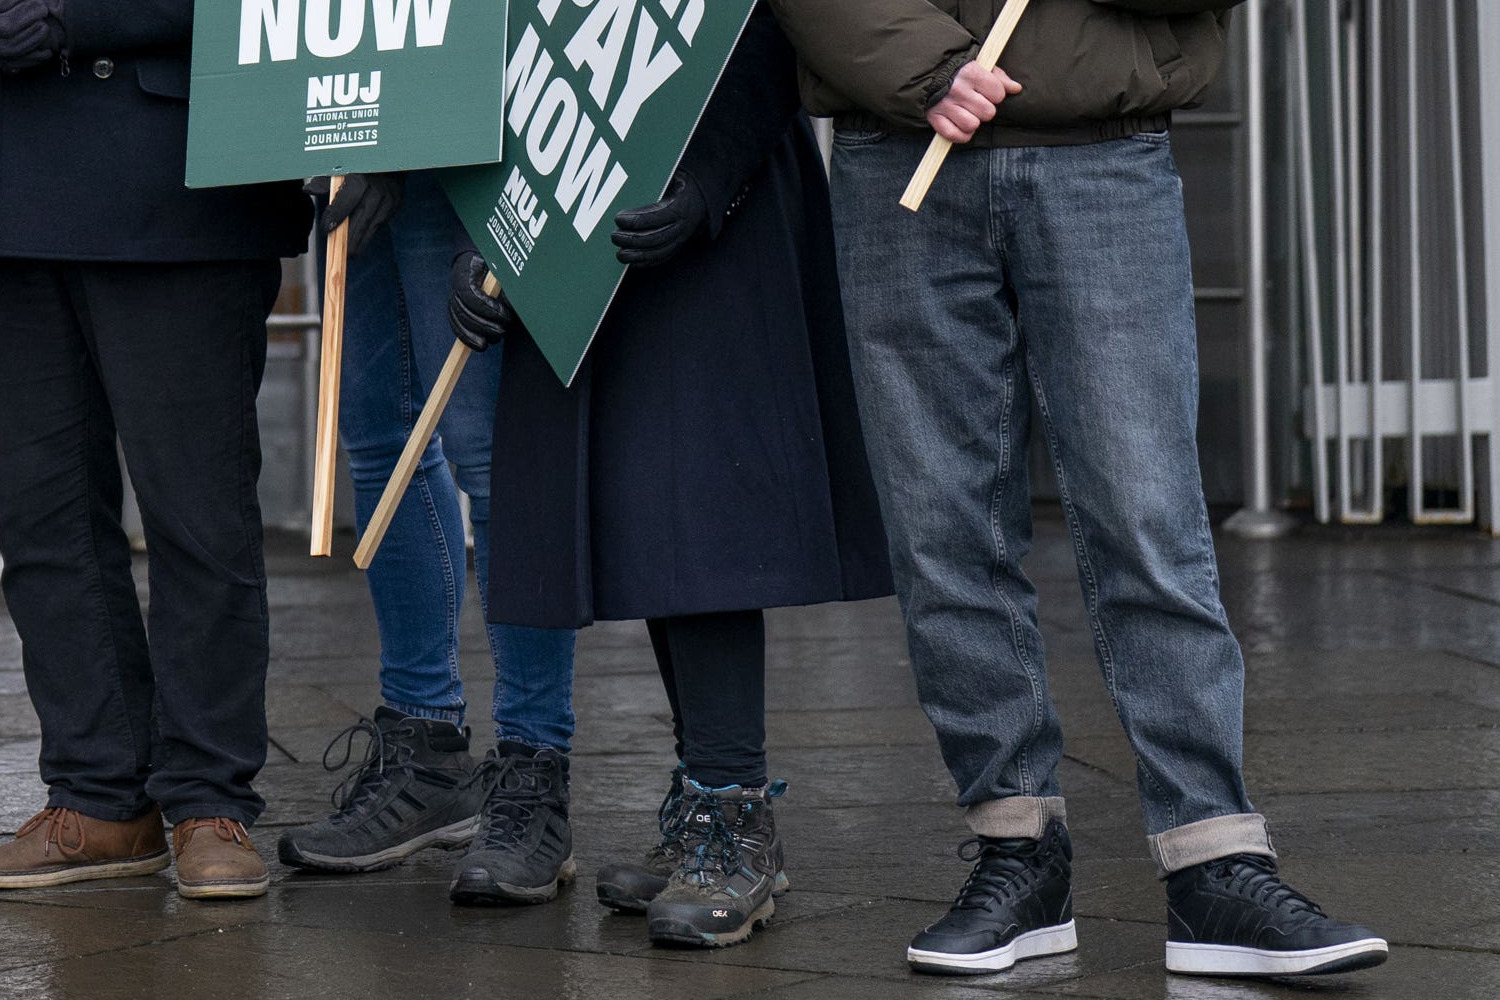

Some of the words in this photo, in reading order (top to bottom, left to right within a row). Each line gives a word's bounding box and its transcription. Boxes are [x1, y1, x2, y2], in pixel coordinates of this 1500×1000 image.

[307, 71, 381, 108] NUJ
[306, 112, 348, 123] NATIONAL
[352, 109, 379, 119] UNION
[337, 122, 347, 130] OF
[505, 23, 628, 241] NOW
[304, 129, 378, 145] JOURNALISTS
[503, 165, 548, 238] NUJ
[489, 215, 525, 271] JOURNALISTS
[498, 196, 518, 231] NATIONAL
[518, 228, 533, 253] UNION
[696, 814, 711, 823] OE
